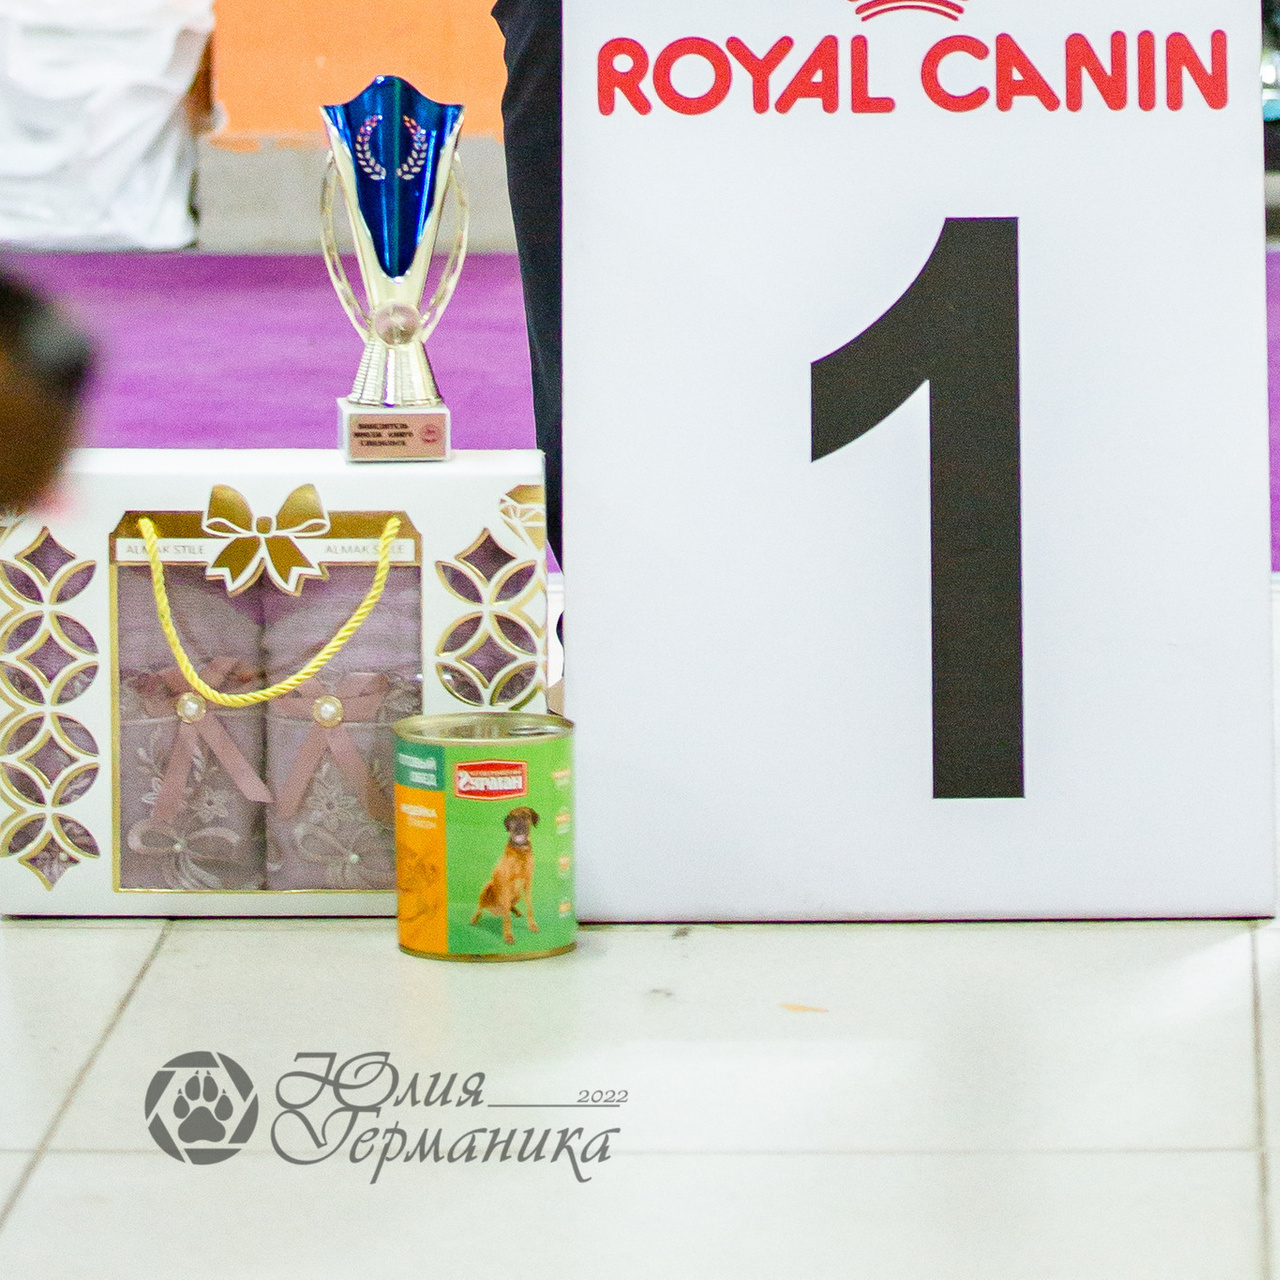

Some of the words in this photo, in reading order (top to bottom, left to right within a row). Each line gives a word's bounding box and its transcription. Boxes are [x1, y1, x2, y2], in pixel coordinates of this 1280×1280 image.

[597, 33, 896, 116] ROYAL
[920, 28, 1228, 113] CANIN
[810, 216, 1025, 799] 1
